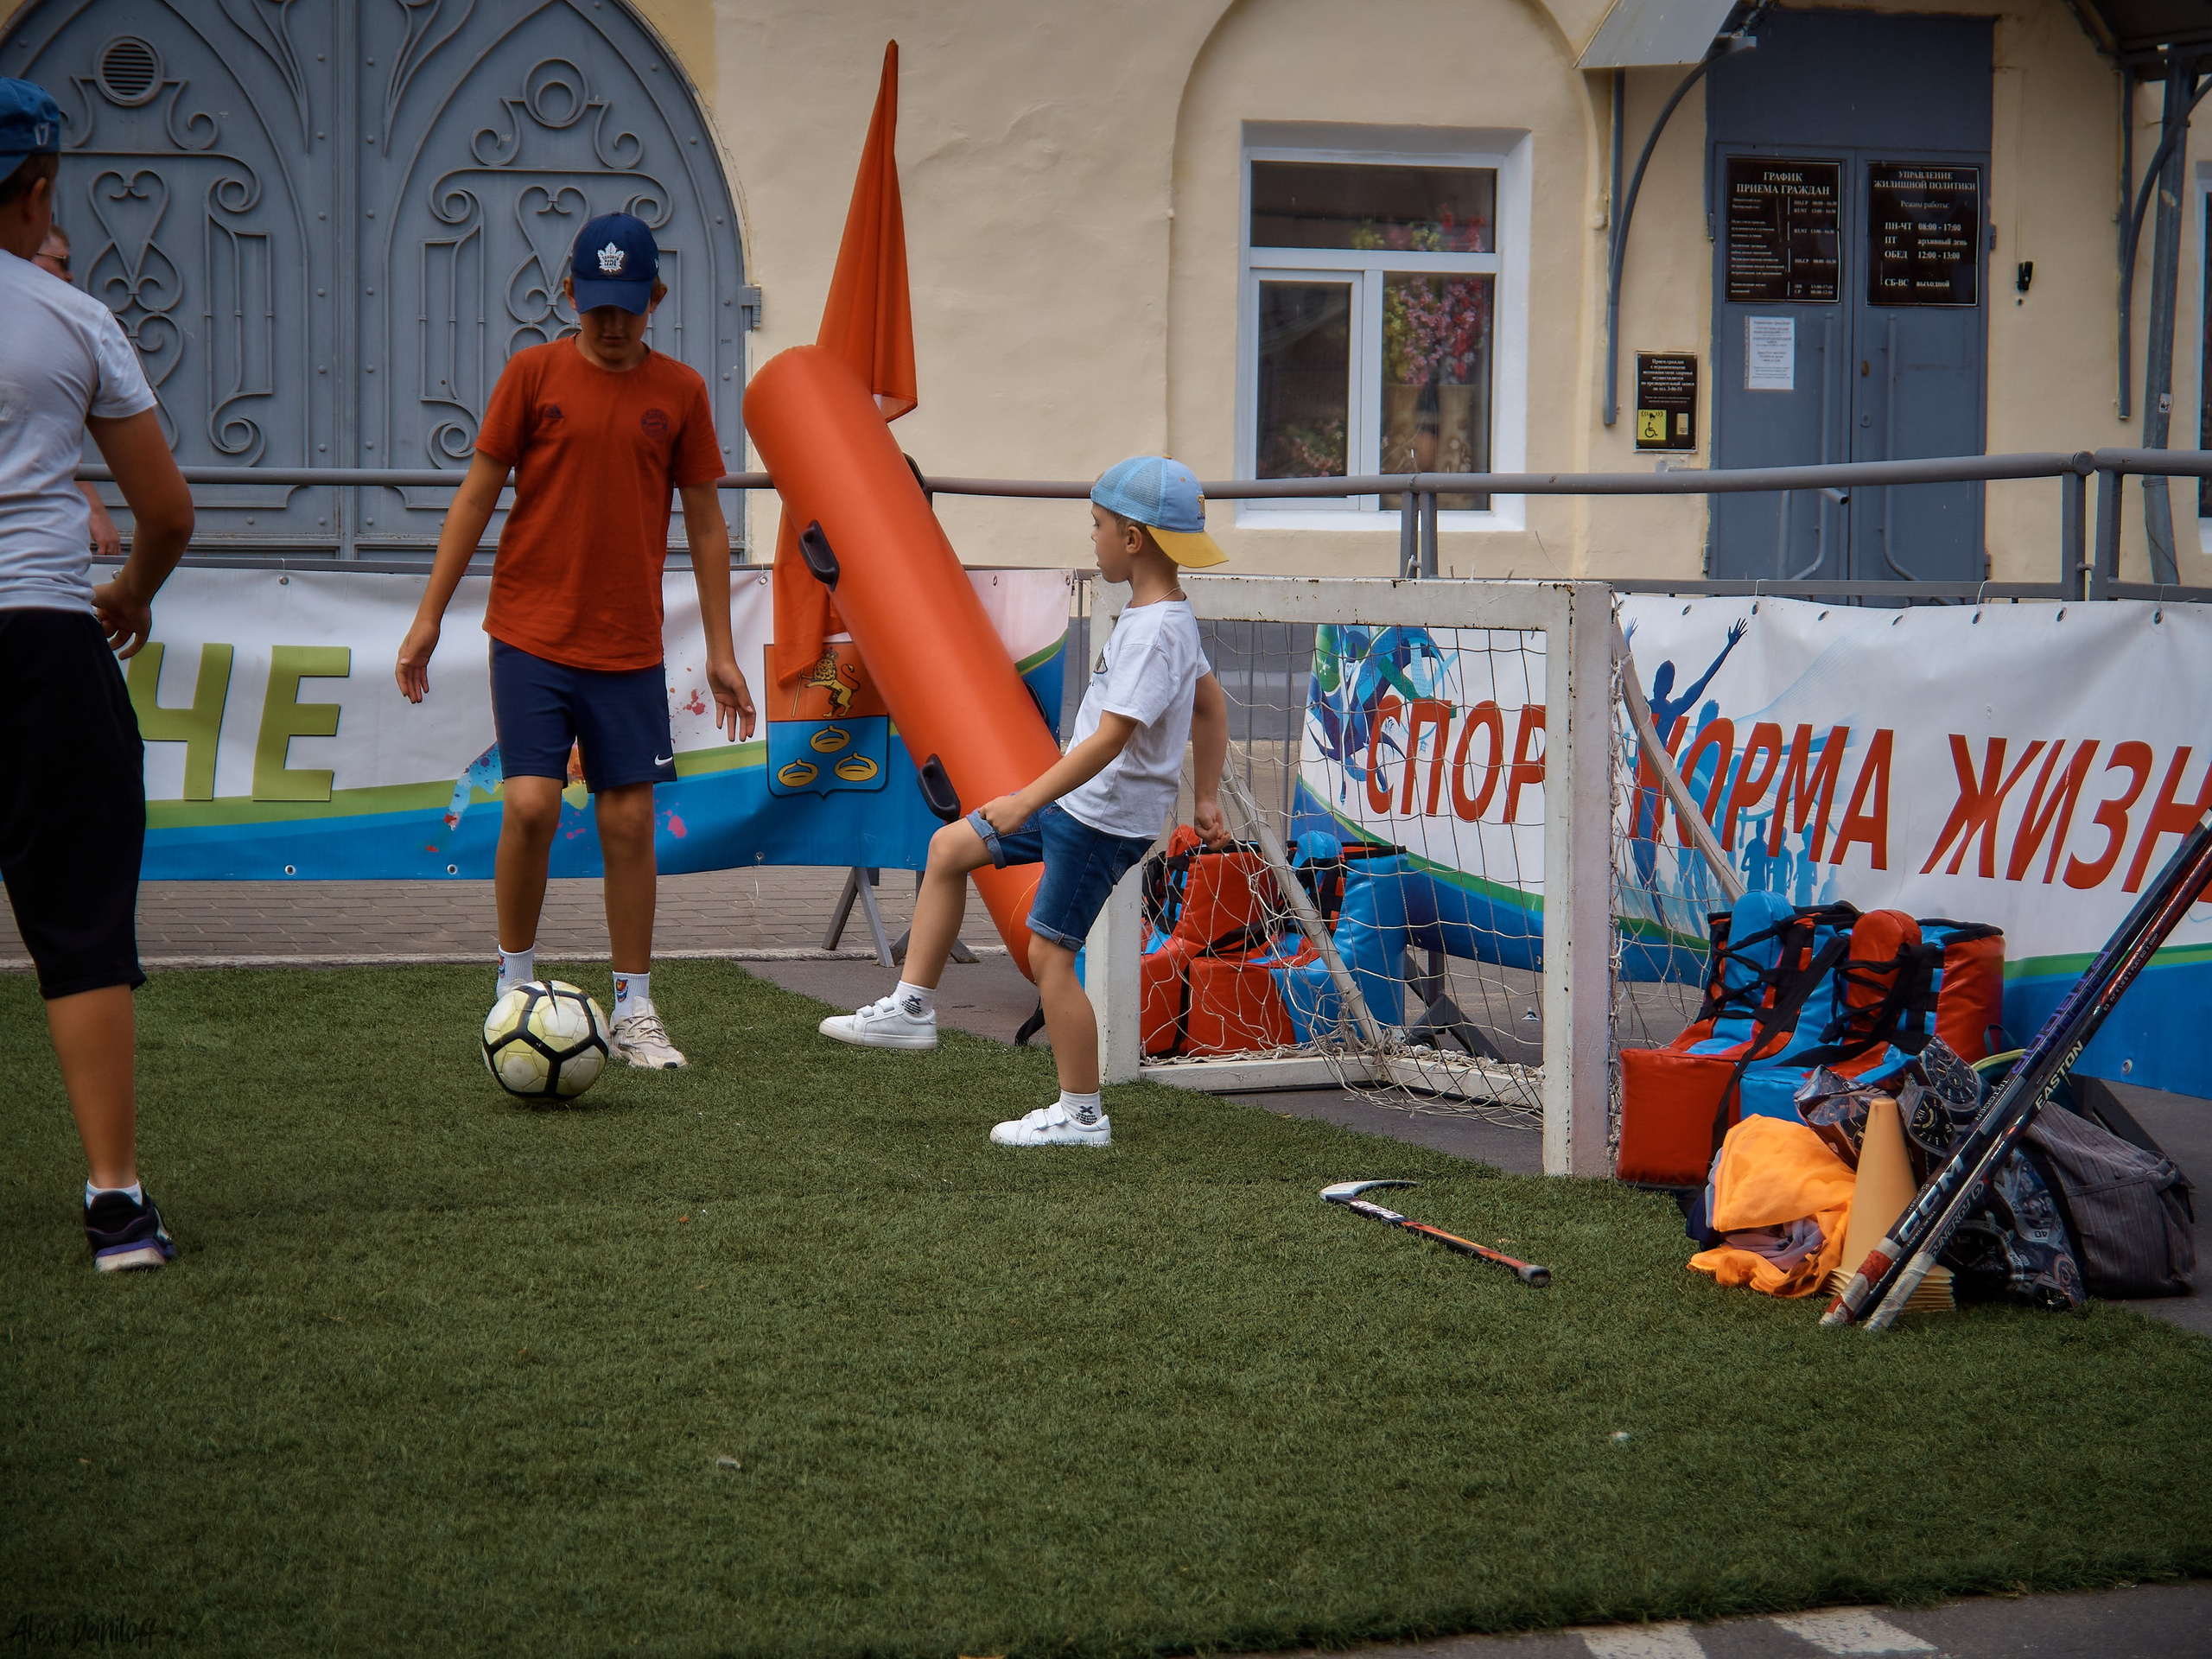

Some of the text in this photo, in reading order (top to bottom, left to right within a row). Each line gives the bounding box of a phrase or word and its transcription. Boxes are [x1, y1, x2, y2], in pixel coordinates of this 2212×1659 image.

[1764, 172, 1803, 181] ГРАФИК
[1898, 170, 1953, 180] УПРАВЛЕНИЕ
[1736, 183, 1830, 195] ПРИЕМА ГРАЖДАН
[1873, 180, 1976, 190] ЖИЛИЩНОЙ ПОЛИТИКИ
[1885, 222, 1913, 231] ПН-ЧТ
[1918, 223, 1937, 232] 08:00
[1943, 224, 1961, 232] 17:00
[1885, 236, 1897, 245] ПТ
[1885, 250, 1908, 259] ОБЕД
[1918, 251, 1936, 259] 12:00
[1885, 278, 1910, 287] СБ-ВС
[1367, 695, 1545, 823] СПОР
[1918, 733, 2212, 904] ЖИЗН
[2035, 1039, 2084, 1111] EASTON
[1898, 1154, 1964, 1243] CCM
